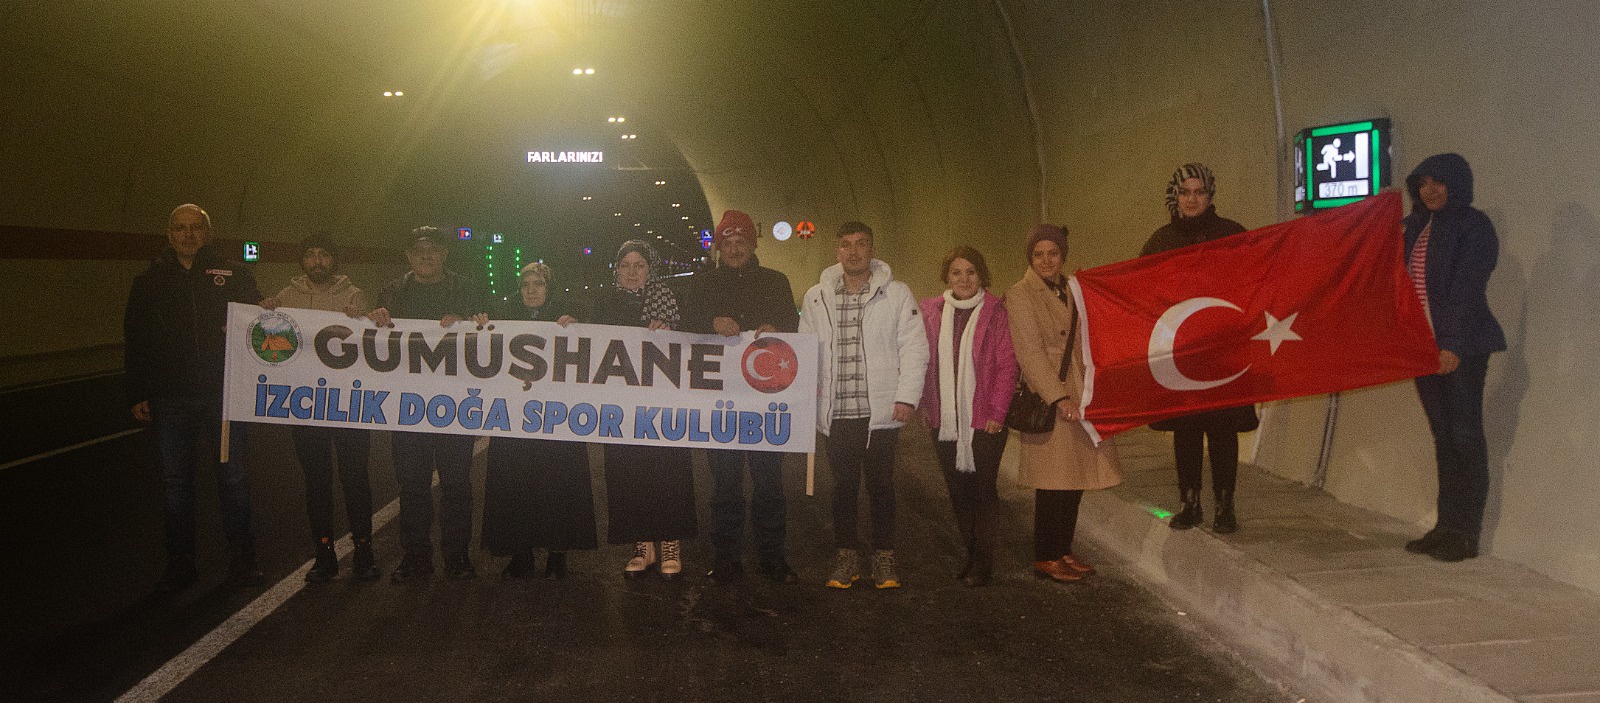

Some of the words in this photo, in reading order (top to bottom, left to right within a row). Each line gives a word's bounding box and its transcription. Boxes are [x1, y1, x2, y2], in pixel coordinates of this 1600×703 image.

[527, 151, 603, 163] FARLARINIZI
[1324, 182, 1344, 197] 370
[1348, 185, 1358, 195] m
[314, 323, 724, 391] GÜMÜŞHANE
[254, 374, 390, 424] İZCİLİK
[398, 388, 511, 431] DOĞA
[521, 399, 624, 438] SPOR
[633, 400, 791, 445] KULÜBÜ
